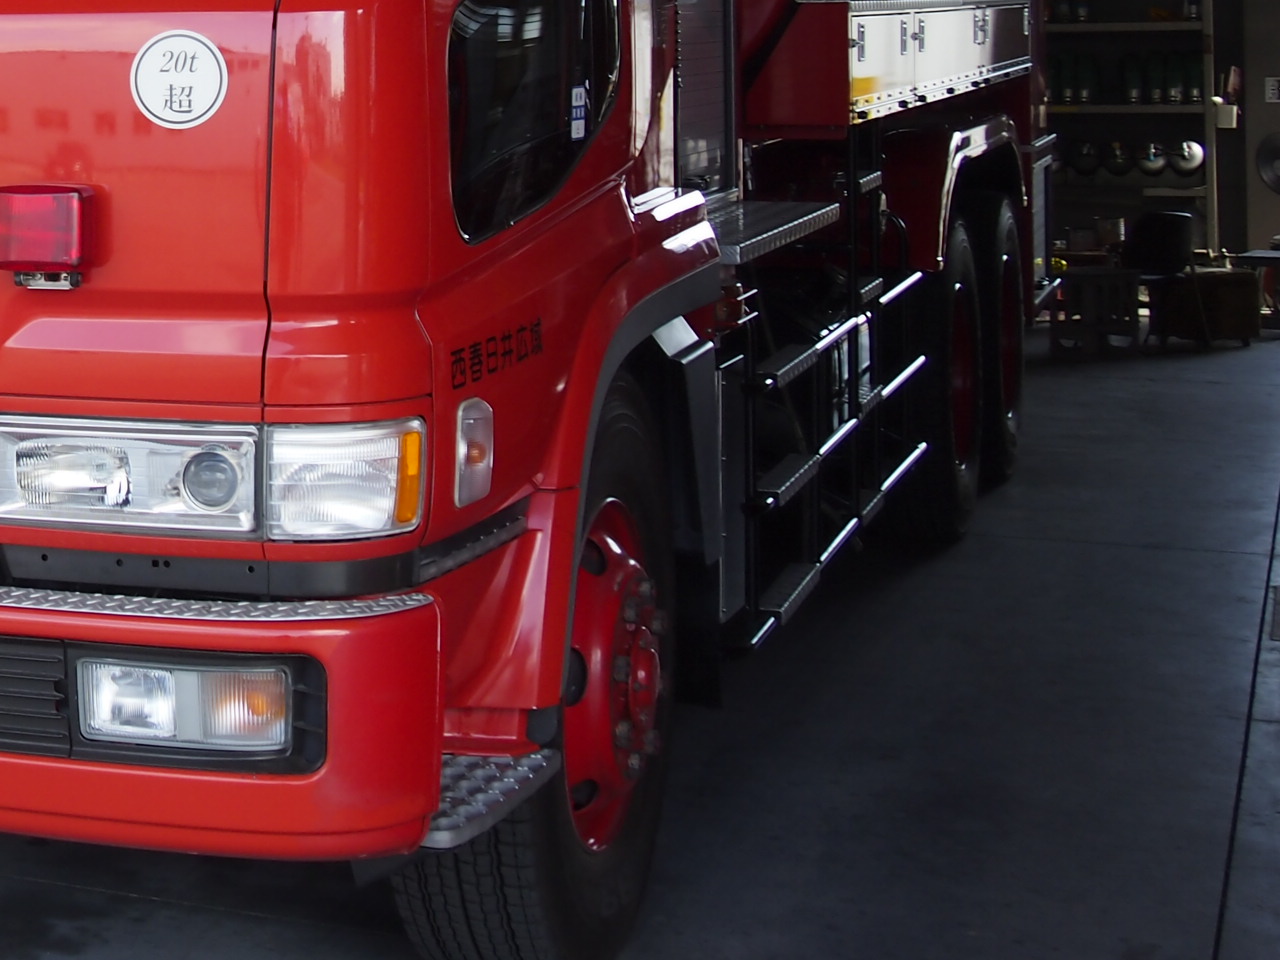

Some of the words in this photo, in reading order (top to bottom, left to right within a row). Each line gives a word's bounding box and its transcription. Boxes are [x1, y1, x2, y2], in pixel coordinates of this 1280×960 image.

[158, 49, 200, 74] 20t
[162, 83, 195, 114] 超
[450, 317, 543, 390] 西春日井広域
